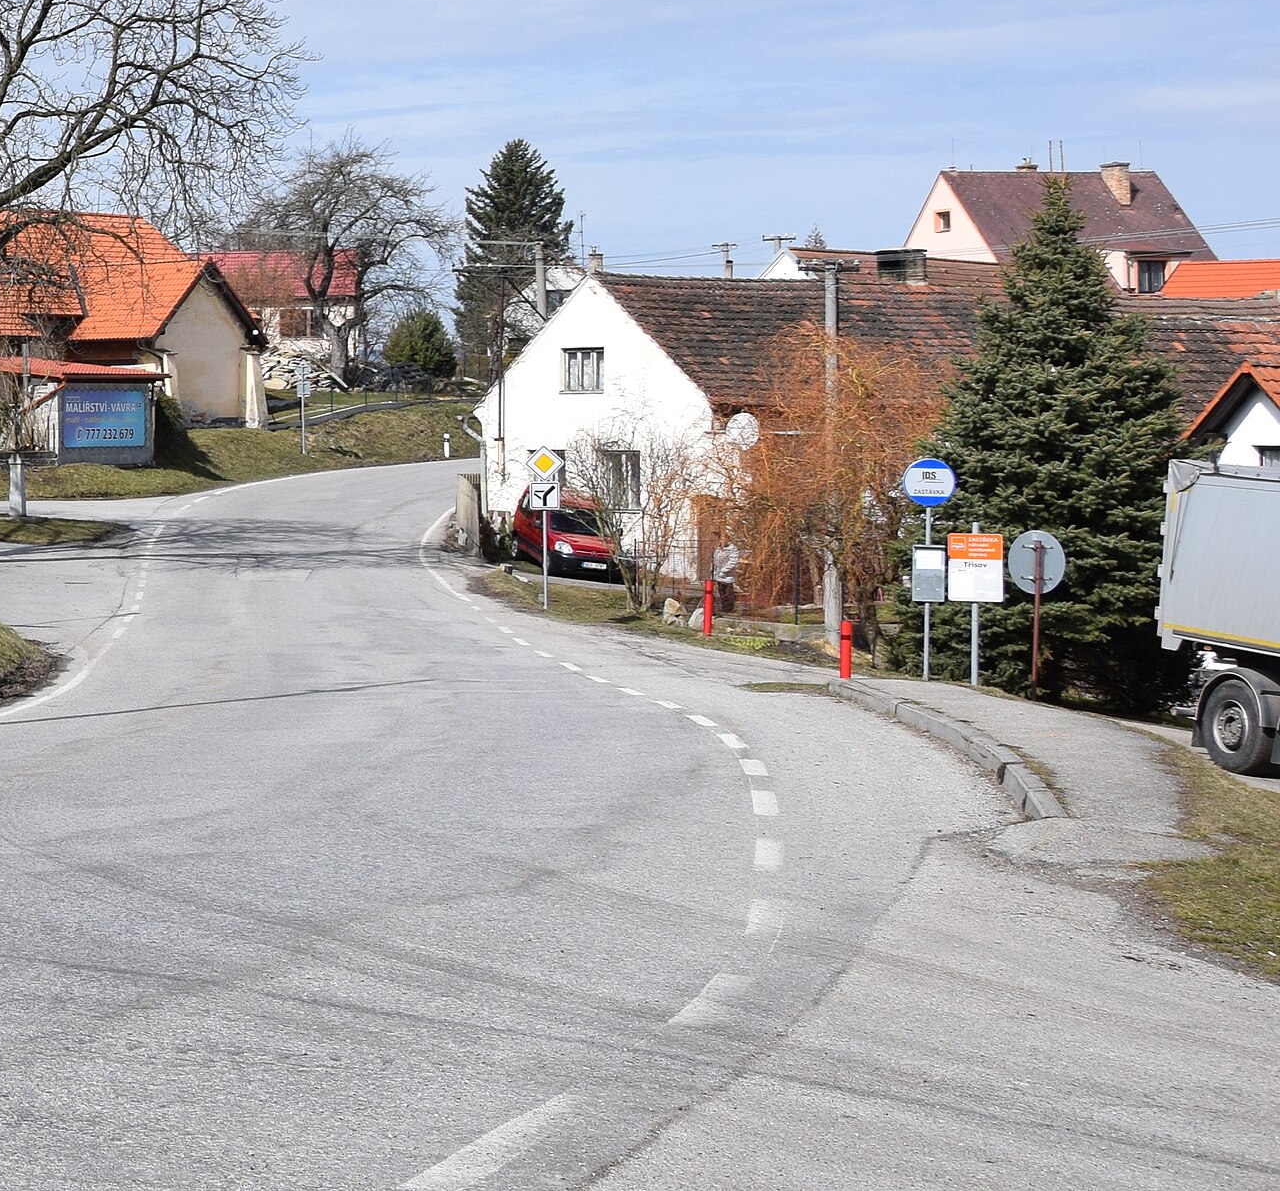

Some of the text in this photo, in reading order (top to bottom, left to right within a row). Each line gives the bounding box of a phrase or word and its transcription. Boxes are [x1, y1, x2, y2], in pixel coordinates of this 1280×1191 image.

[85, 428, 134, 440] 777 232 679
